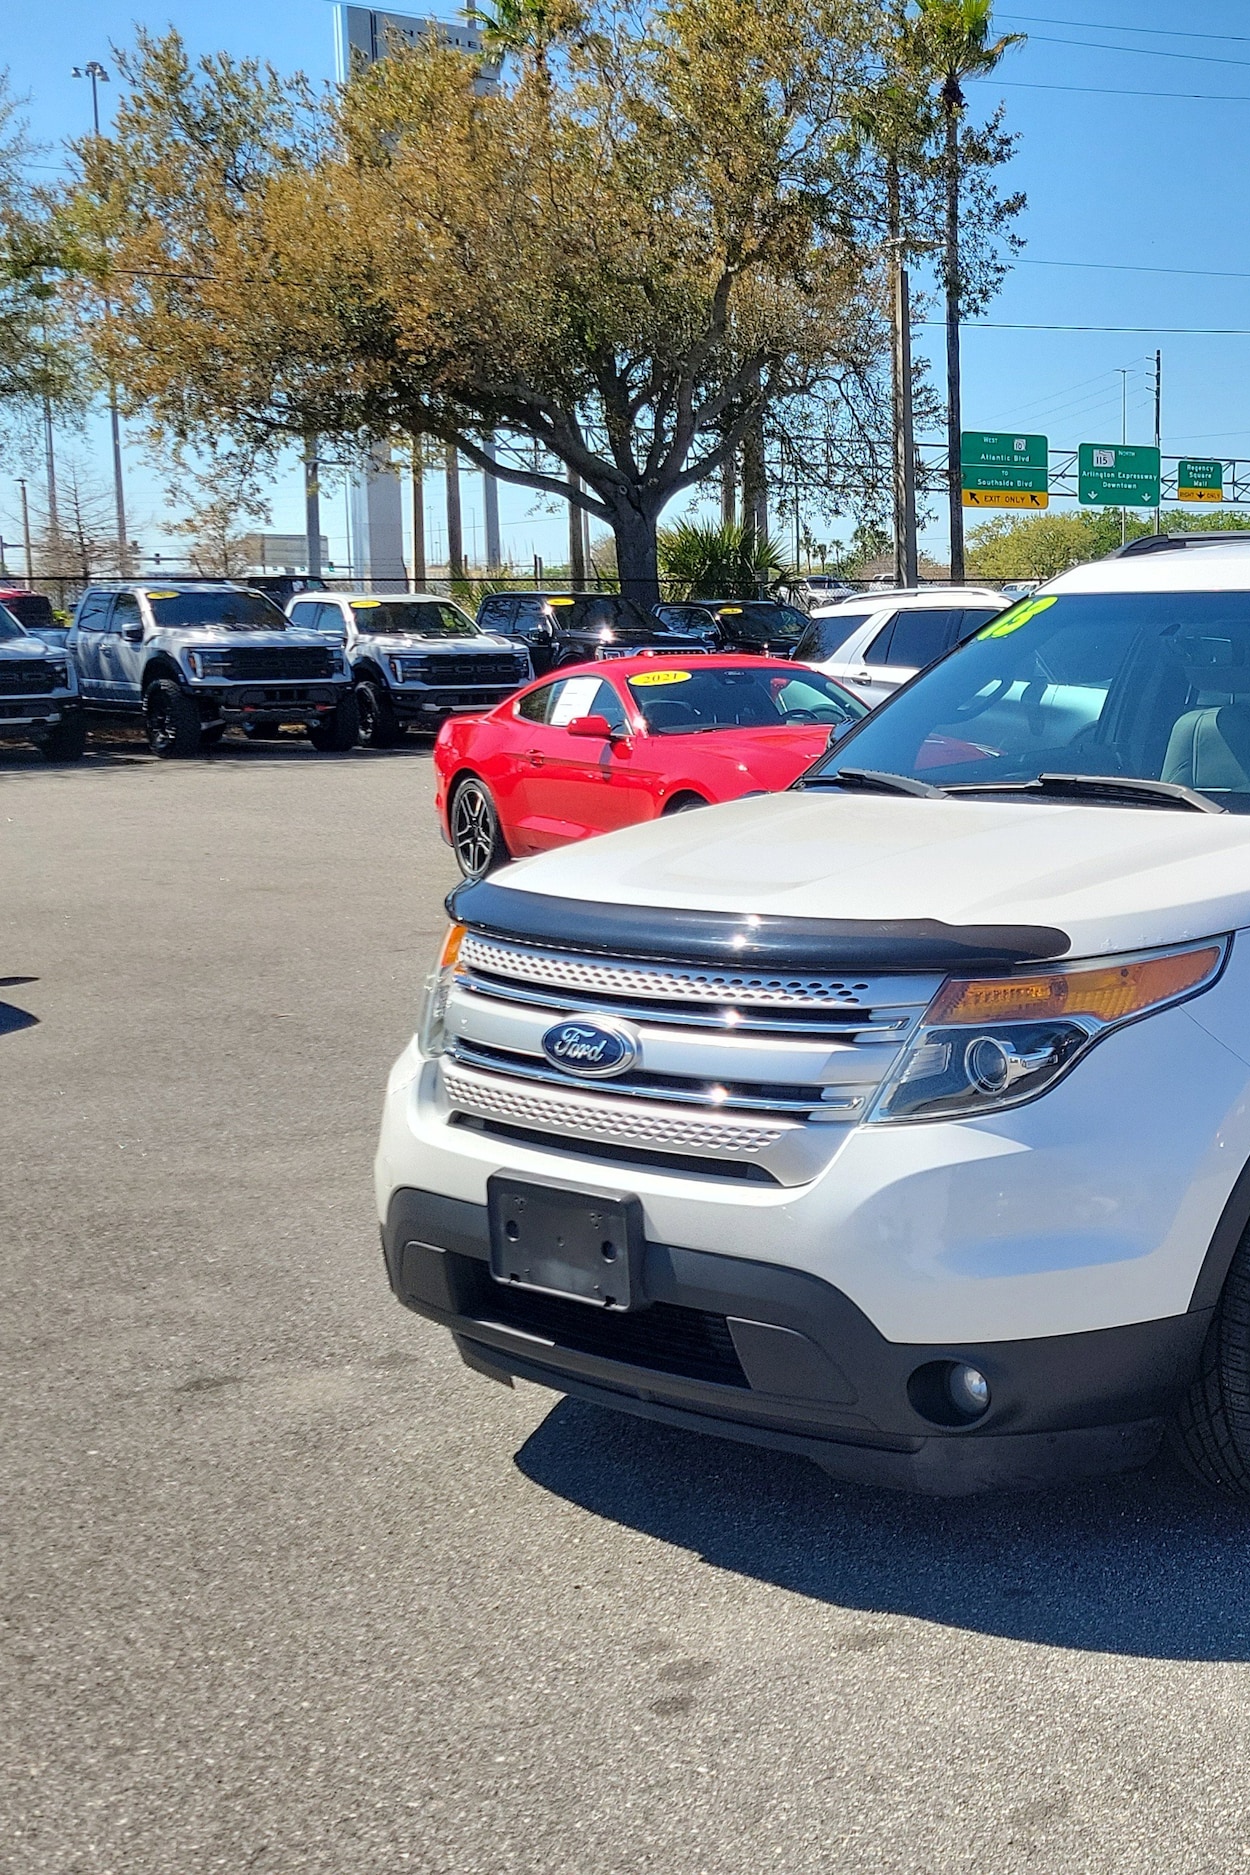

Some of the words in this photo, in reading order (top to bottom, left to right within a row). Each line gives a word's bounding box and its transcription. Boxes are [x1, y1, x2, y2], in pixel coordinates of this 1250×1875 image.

[980, 453, 1011, 462] Atlantic
[1096, 456, 1108, 465] 115
[1186, 464, 1214, 473] Regency
[1082, 470, 1115, 479] Arlington
[1117, 471, 1158, 481] Expressway
[1189, 471, 1212, 480] Square
[977, 478, 1014, 487] Southside
[1017, 479, 1033, 488] Blvd
[1102, 481, 1137, 489] Downtown
[984, 495, 1001, 503] EXIT
[1004, 496, 1025, 504] ONLY
[977, 596, 1058, 640] 13
[431, 665, 516, 674] FORD
[642, 672, 679, 684] 2021
[554, 1027, 608, 1062] Ford
